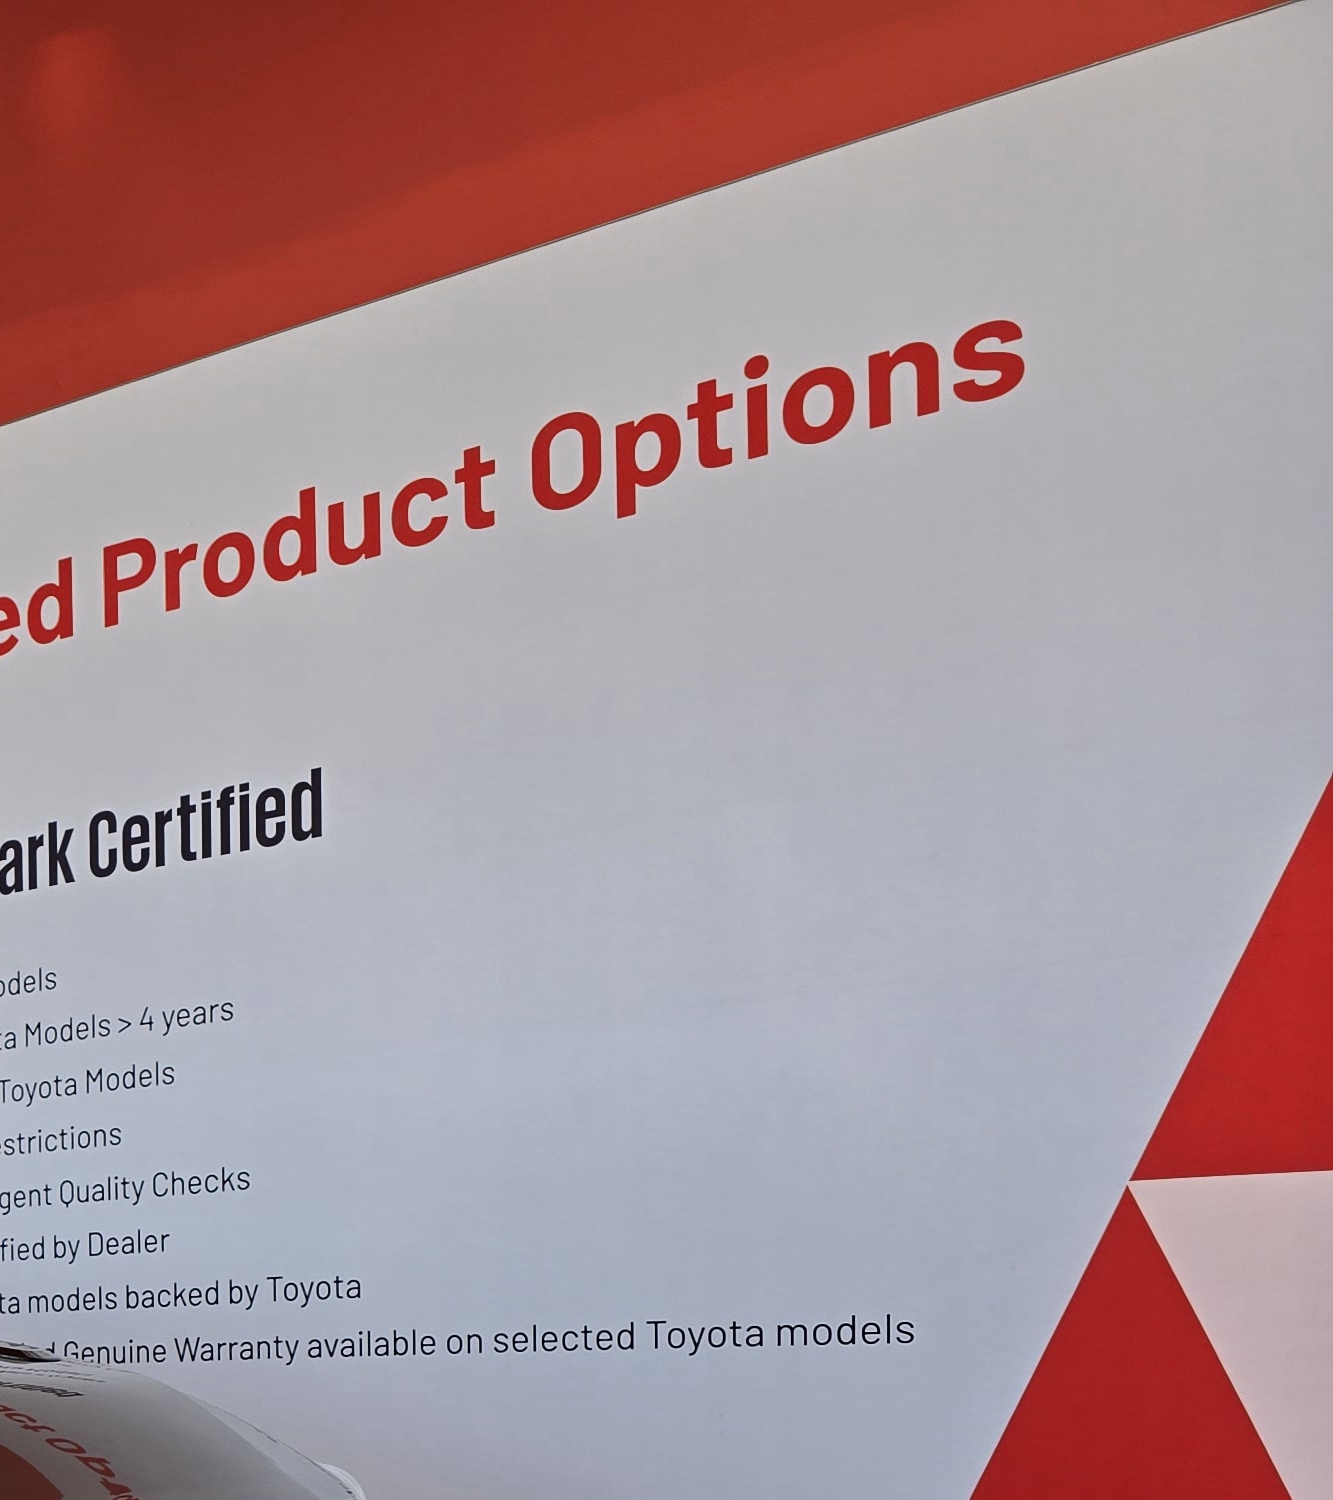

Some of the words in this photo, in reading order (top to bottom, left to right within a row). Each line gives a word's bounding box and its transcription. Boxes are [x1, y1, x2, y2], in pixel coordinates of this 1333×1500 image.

[101, 445, 498, 628] Product
[532, 318, 1027, 519] Options
[89, 766, 324, 878] Certified
[23, 1012, 112, 1048] Models
[116, 1016, 133, 1034] >
[138, 1006, 156, 1032] 4
[161, 999, 236, 1037] years
[85, 1060, 177, 1094] Models
[58, 1174, 147, 1208] Quality
[151, 1165, 252, 1200] Checks
[53, 1234, 82, 1265] by
[87, 1228, 171, 1258] Dealer
[27, 1283, 119, 1314] models
[124, 1278, 222, 1310] backed
[226, 1278, 260, 1312] by
[265, 1273, 363, 1307] Toyota
[64, 1338, 167, 1364] Genuine
[173, 1335, 303, 1366] Warranty
[306, 1328, 438, 1359] available
[445, 1332, 484, 1356] on
[492, 1320, 635, 1354] selected
[646, 1317, 765, 1356] Toyota
[775, 1313, 916, 1347] models
